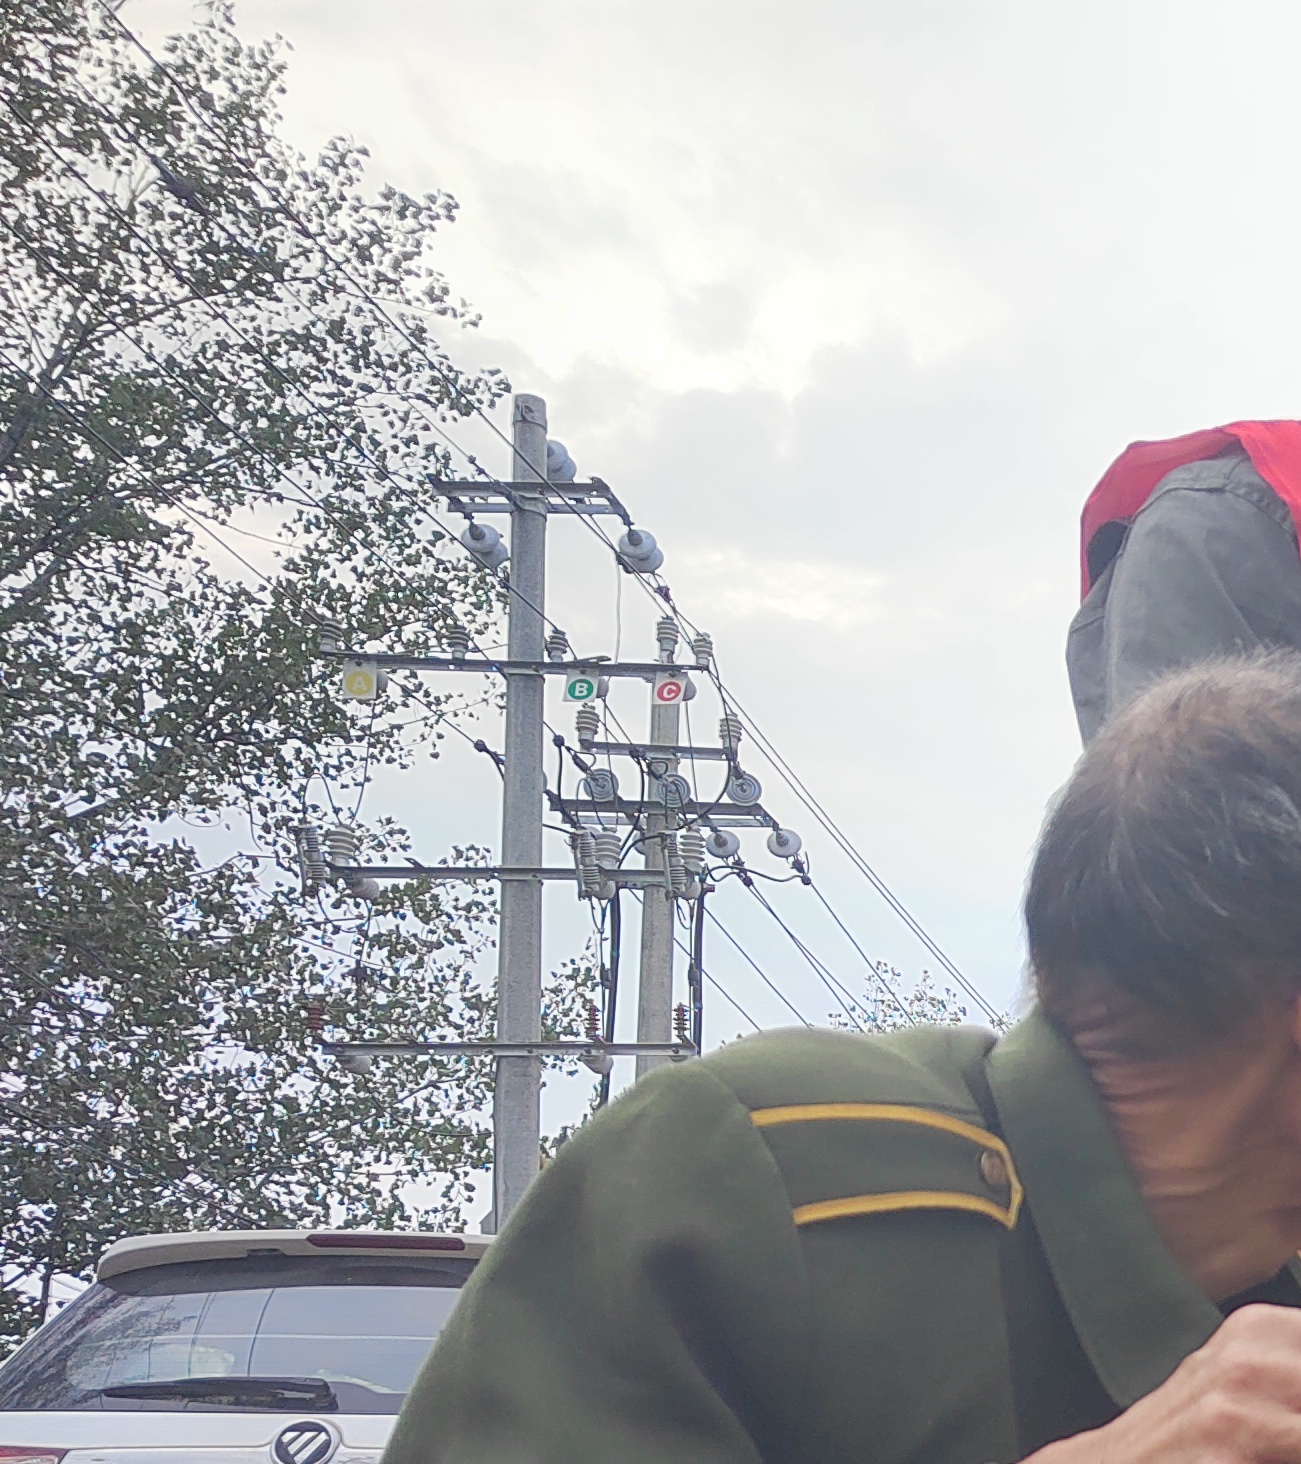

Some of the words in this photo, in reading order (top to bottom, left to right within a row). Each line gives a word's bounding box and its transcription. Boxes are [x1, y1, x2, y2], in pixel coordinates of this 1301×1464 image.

[353, 674, 368, 691] A
[573, 682, 590, 697] B
[661, 684, 678, 699] C
